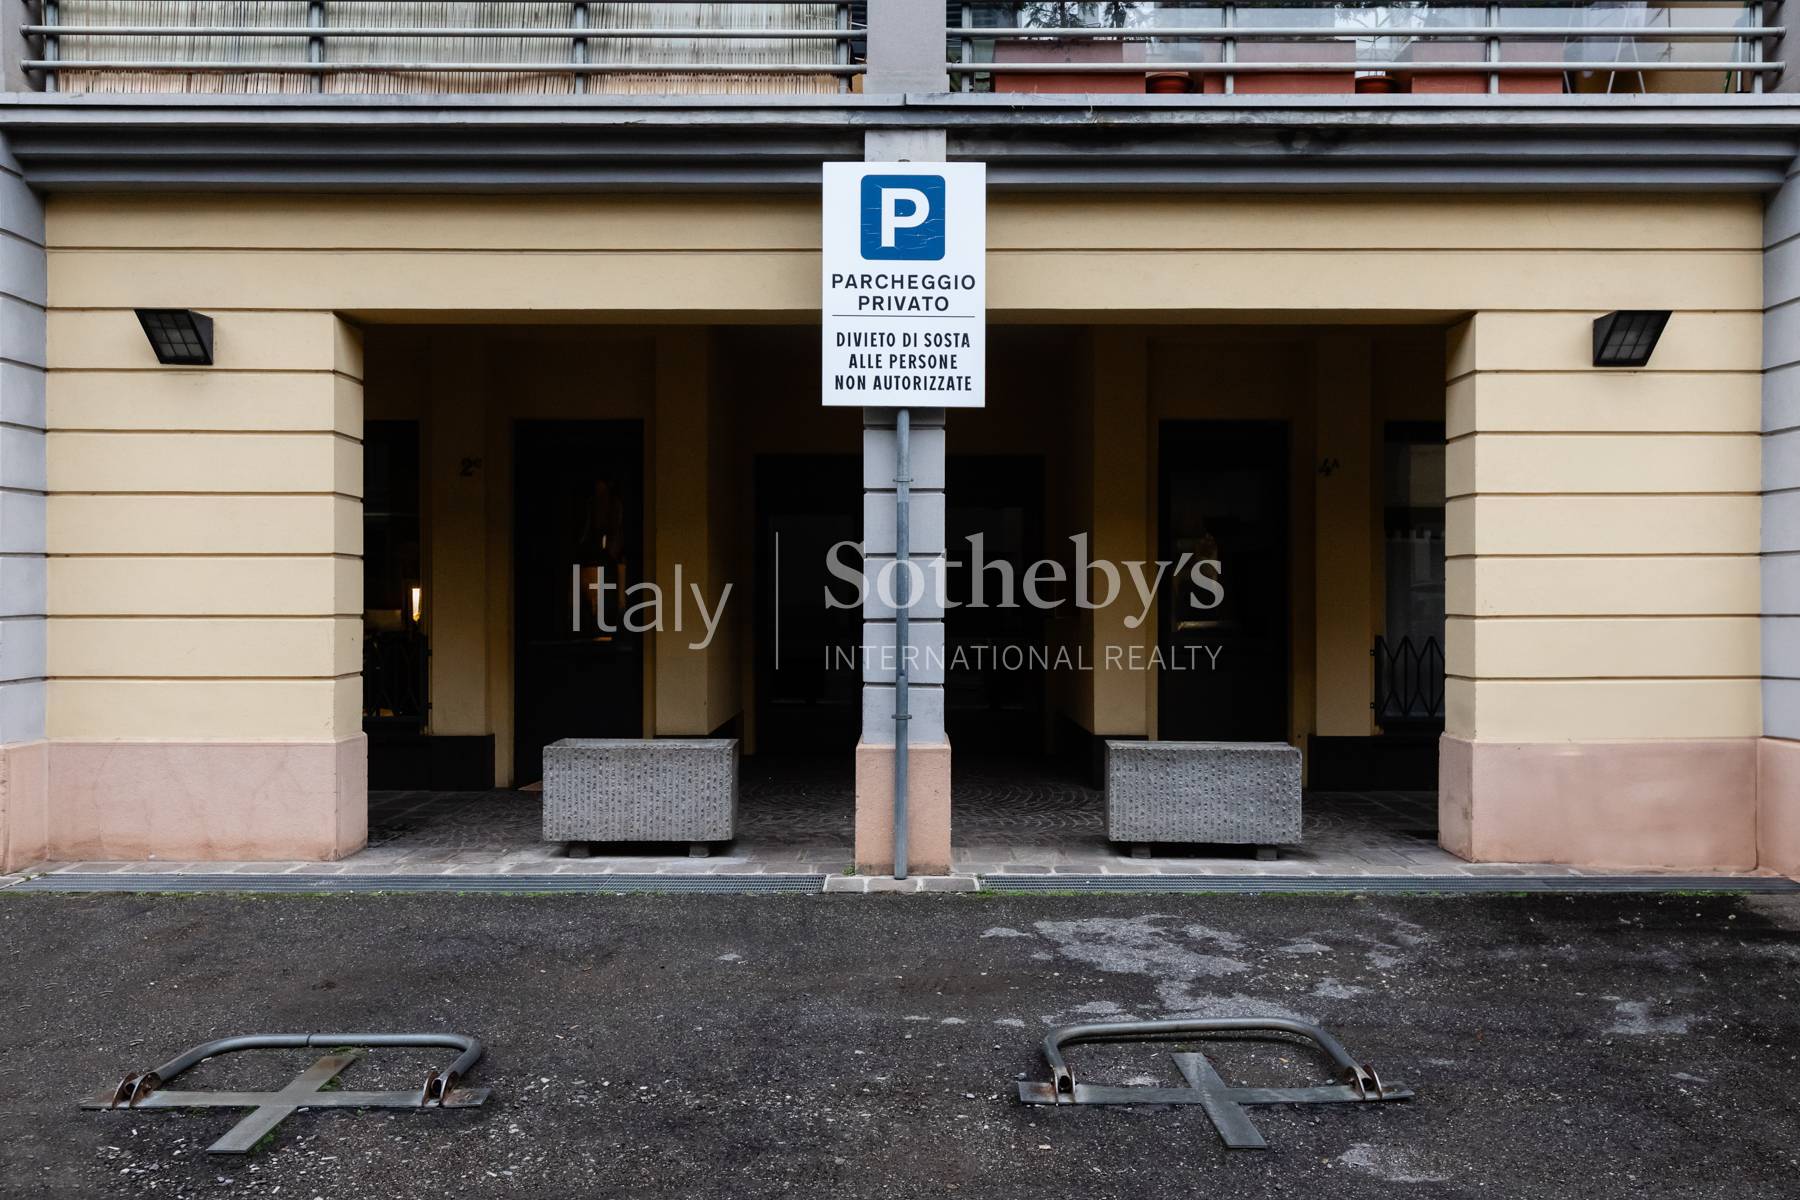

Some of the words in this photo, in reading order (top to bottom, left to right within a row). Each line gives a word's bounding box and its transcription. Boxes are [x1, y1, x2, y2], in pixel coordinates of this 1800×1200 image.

[881, 187, 930, 248] P
[832, 273, 976, 290] PARCHEGGIO
[858, 296, 950, 312] PRIVATO
[836, 332, 896, 348] DIVIETO
[903, 332, 918, 348] DI
[924, 332, 971, 348] SOSTA
[848, 354, 883, 369] ALLE
[889, 354, 958, 370] PERSONE
[834, 375, 866, 390] NON
[873, 375, 972, 391] AUTORIZZATE
